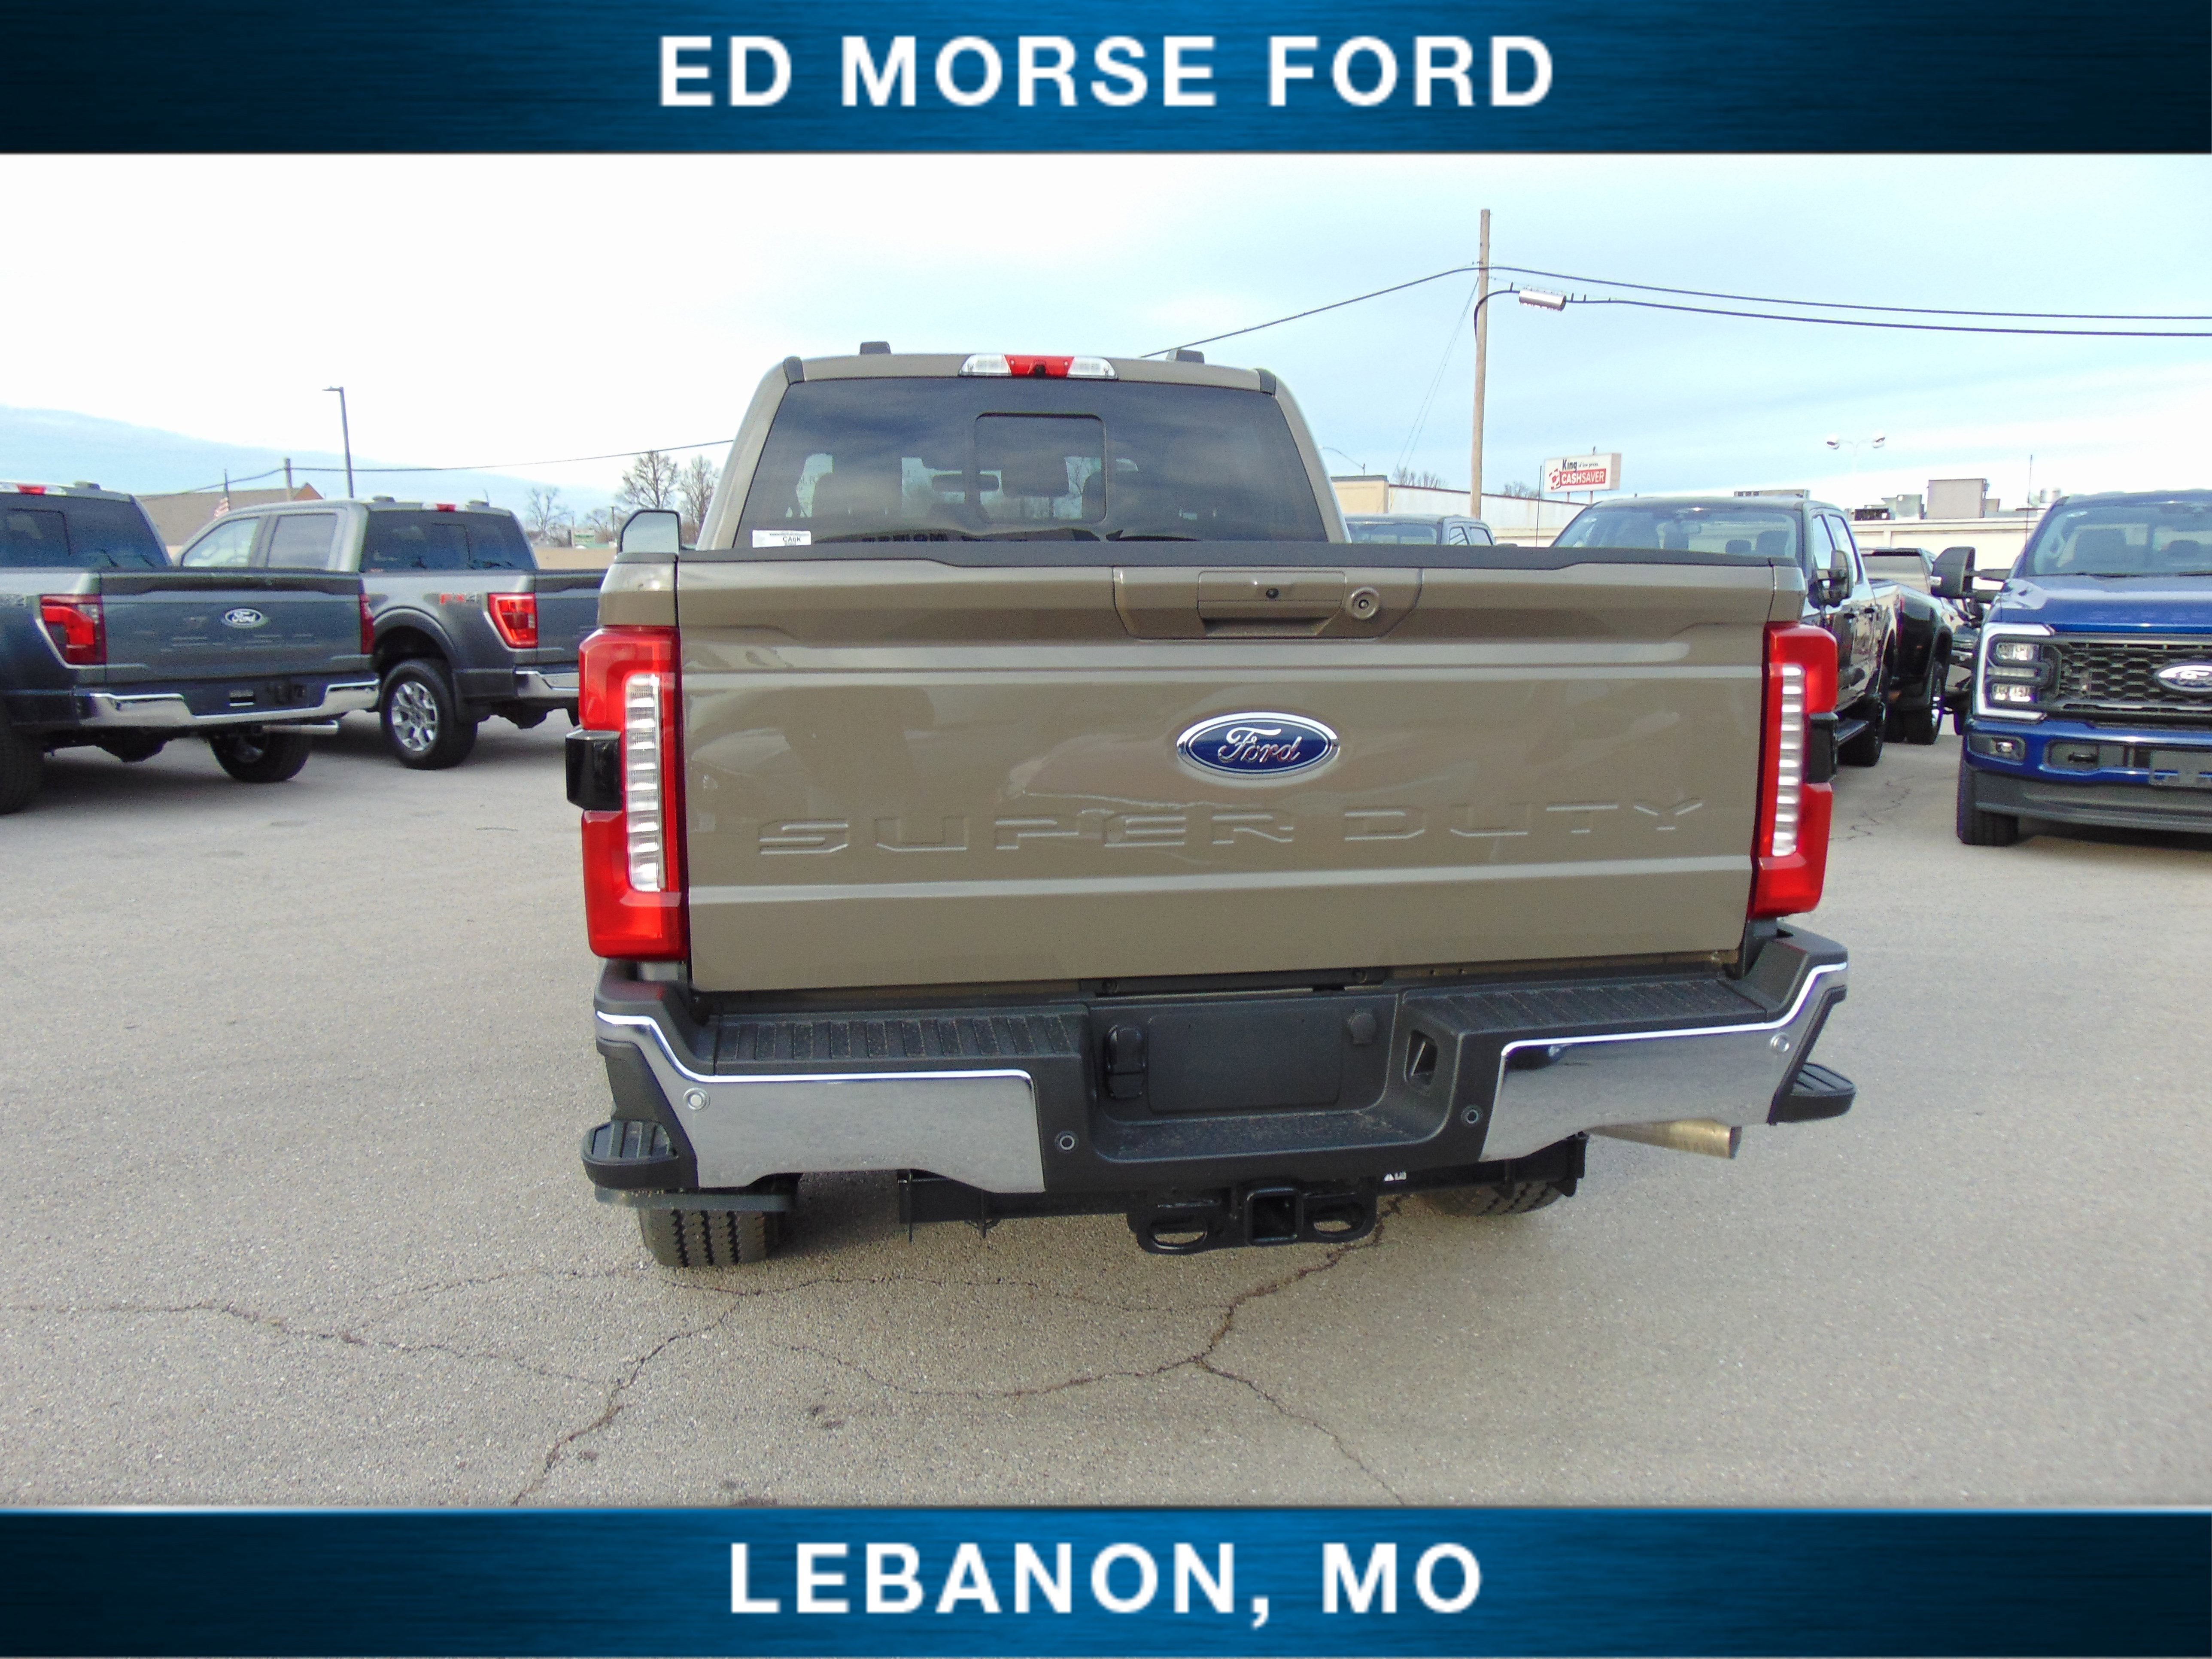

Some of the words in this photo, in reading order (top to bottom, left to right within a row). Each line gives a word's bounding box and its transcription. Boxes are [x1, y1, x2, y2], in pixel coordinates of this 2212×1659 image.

[1562, 459, 1577, 473] King
[1562, 471, 1604, 484] CASHSAVER
[1218, 727, 1303, 763] Ford
[758, 809, 1294, 854] SUPER
[1344, 798, 1704, 841] DUTY
